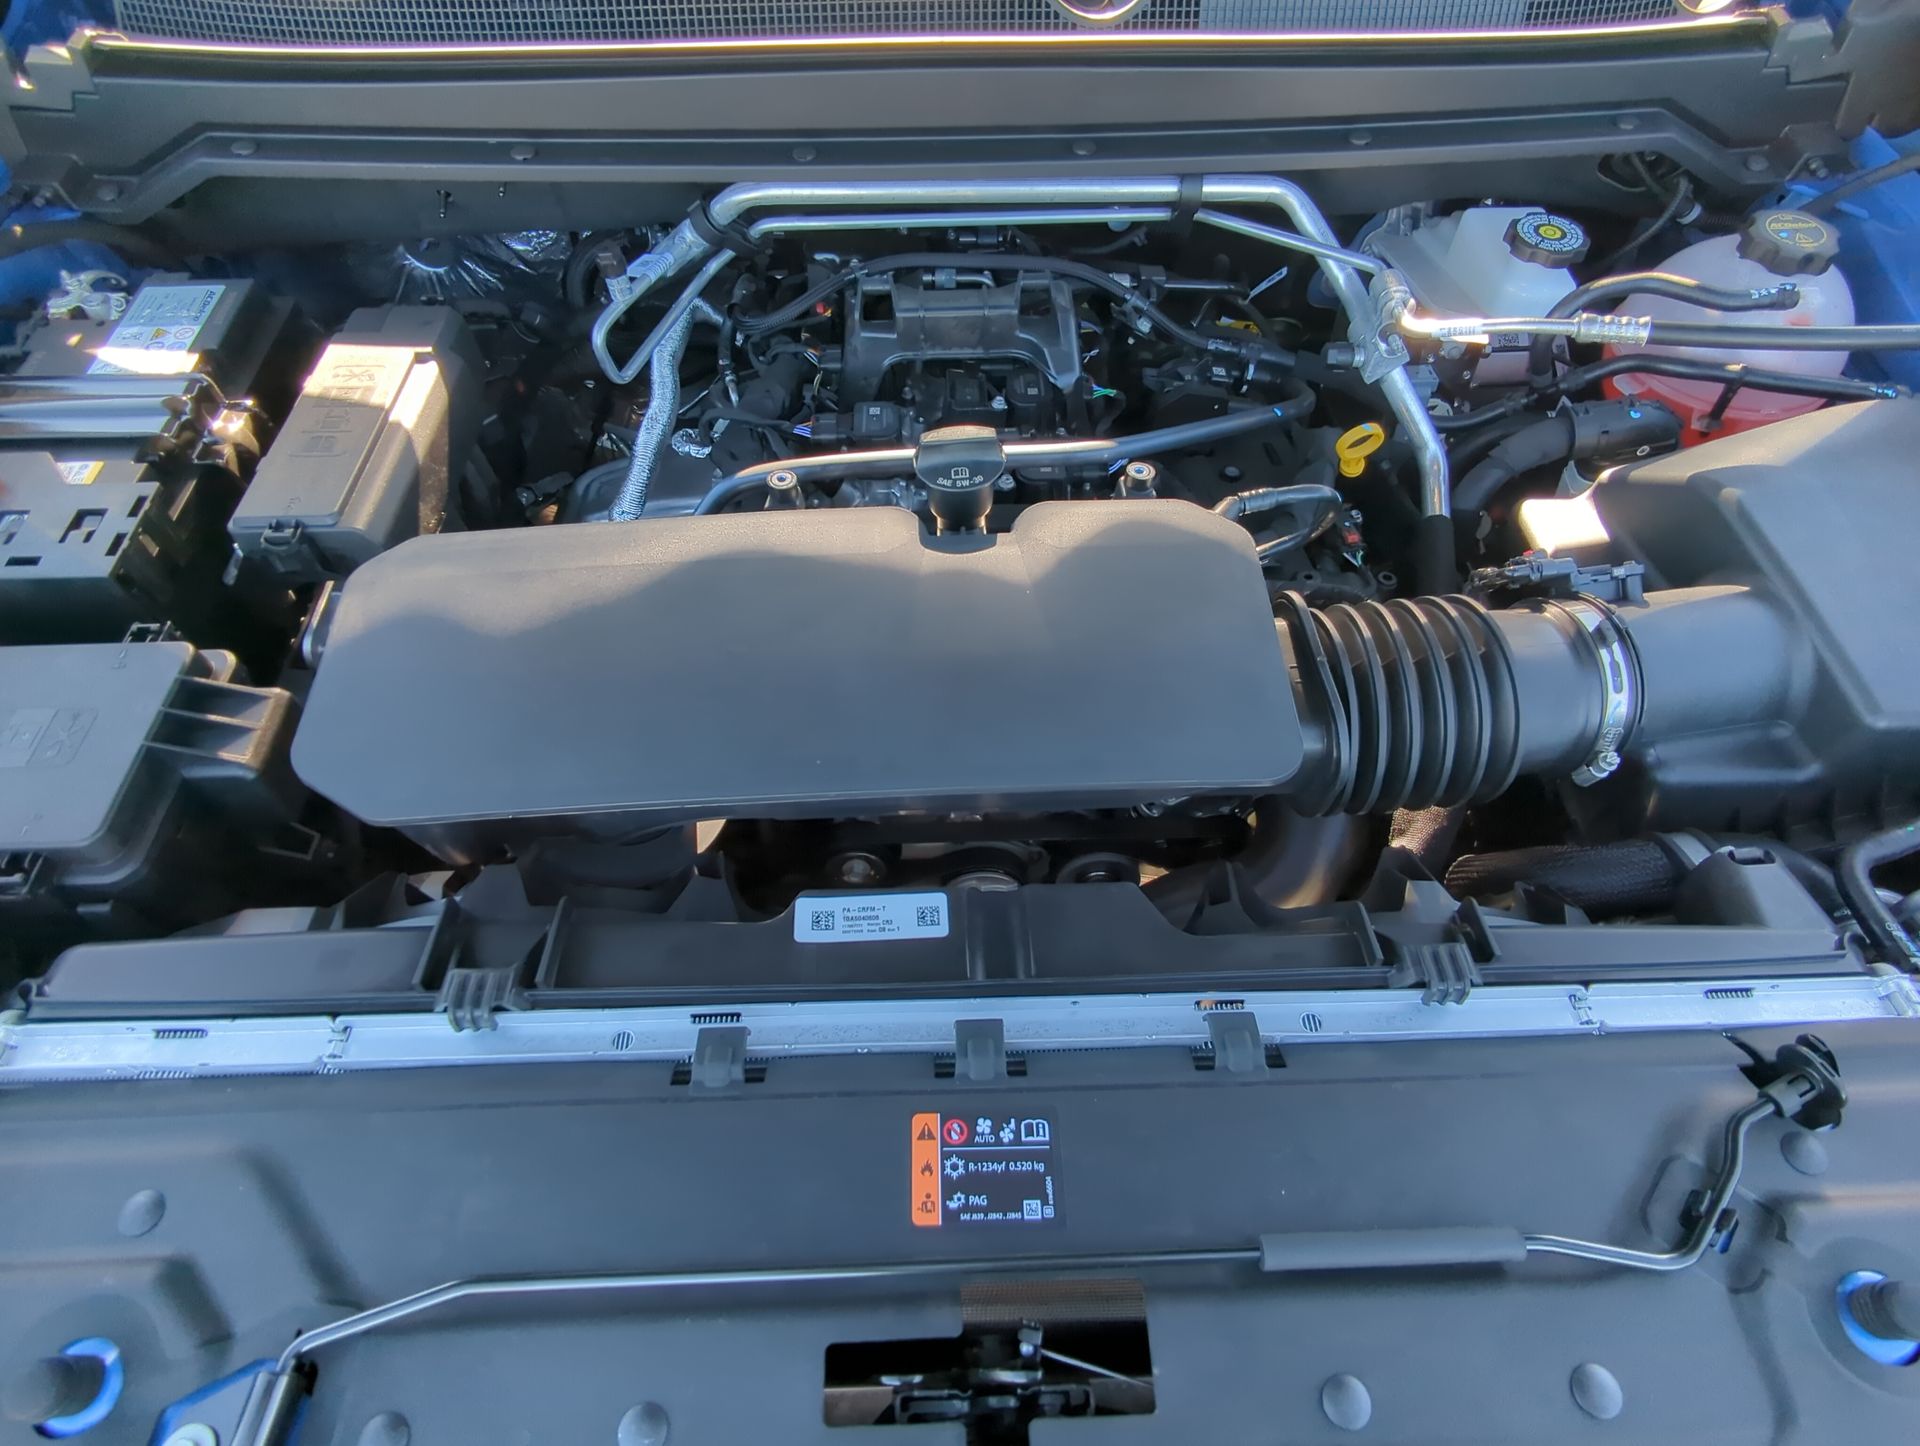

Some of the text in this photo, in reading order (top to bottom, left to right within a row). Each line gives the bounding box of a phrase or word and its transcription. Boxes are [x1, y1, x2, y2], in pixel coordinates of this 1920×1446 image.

[937, 475, 984, 487] SAE 5W-30
[974, 1134, 995, 1143] AUTO
[968, 1161, 1044, 1173] R-1234yf 0.520 kg
[968, 1195, 988, 1205] PAG
[960, 1212, 971, 1220] SAE
